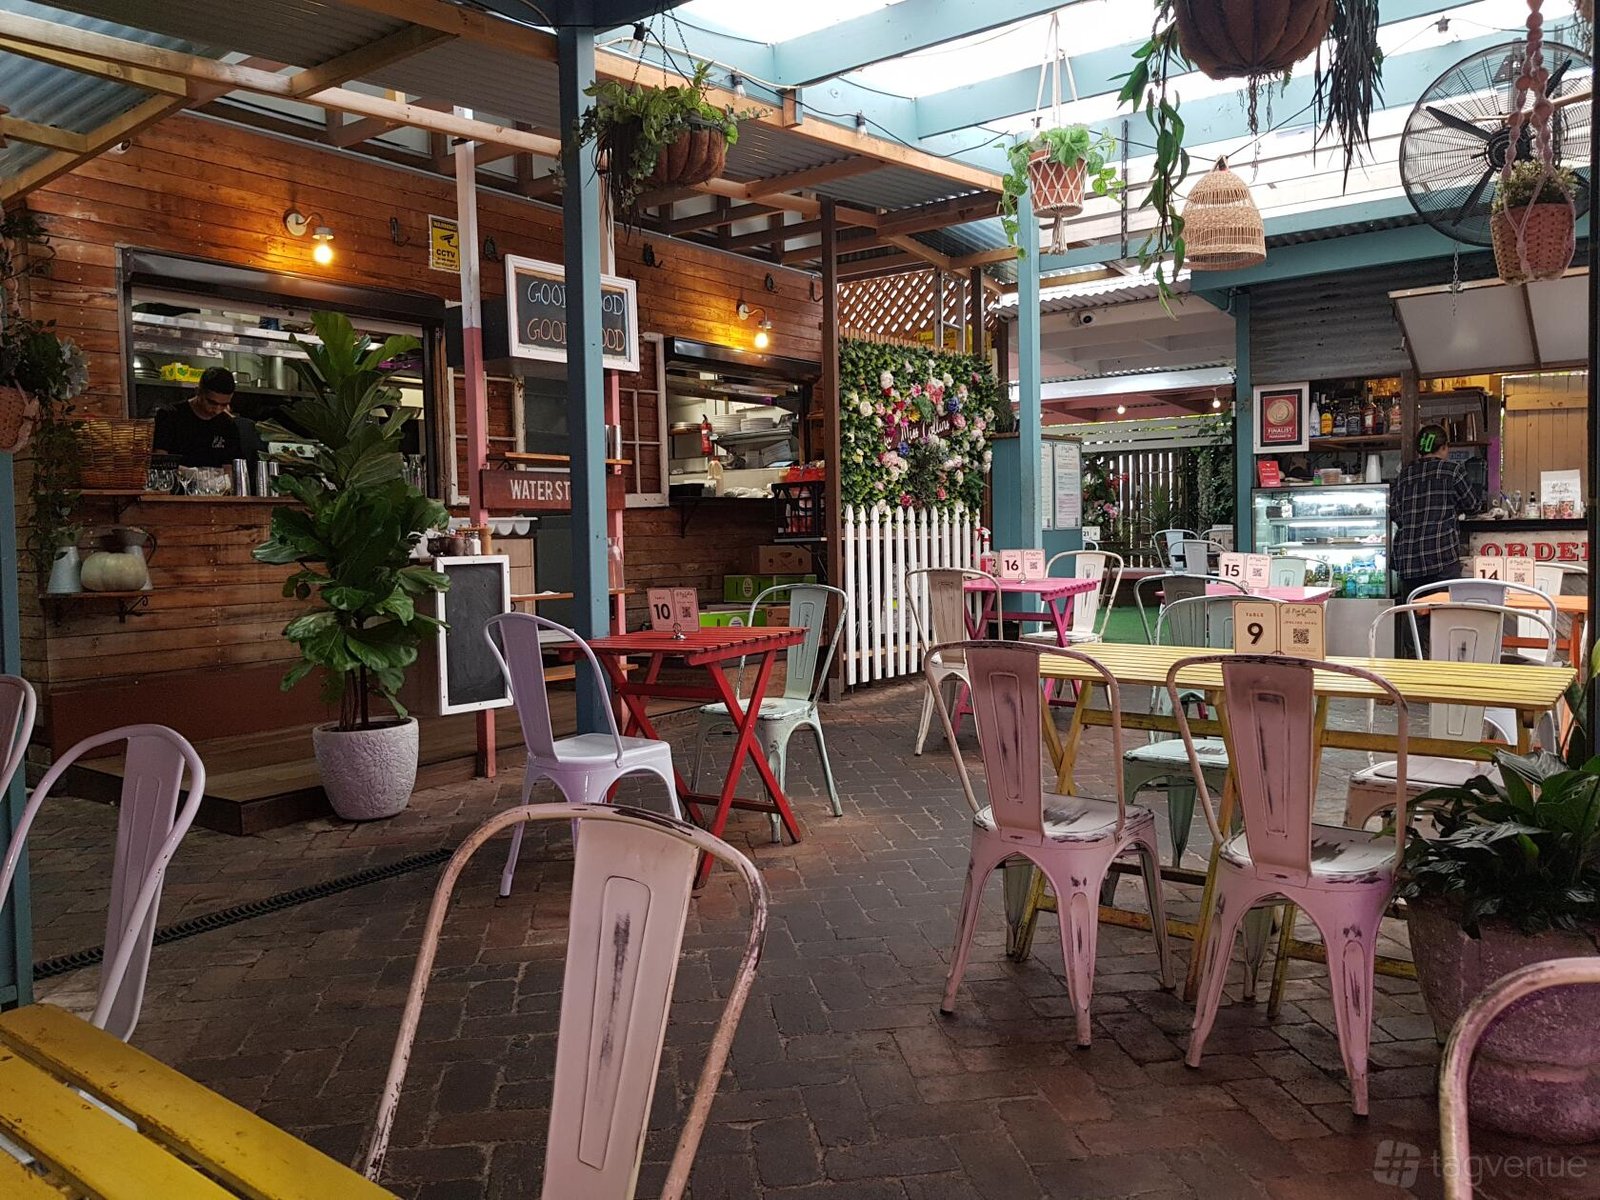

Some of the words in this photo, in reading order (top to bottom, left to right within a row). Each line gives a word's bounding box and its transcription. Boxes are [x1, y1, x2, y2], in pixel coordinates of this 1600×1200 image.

[436, 248, 456, 258] CCTV
[527, 281, 566, 309] GOO
[527, 318, 567, 345] GOO
[510, 479, 552, 501] WATER
[1480, 541, 1590, 562] ORDE
[1004, 559, 1019, 571] 16
[1224, 563, 1240, 577] 15
[1479, 569, 1499, 580] 14
[653, 603, 671, 620] 10
[1247, 622, 1264, 646] 9
